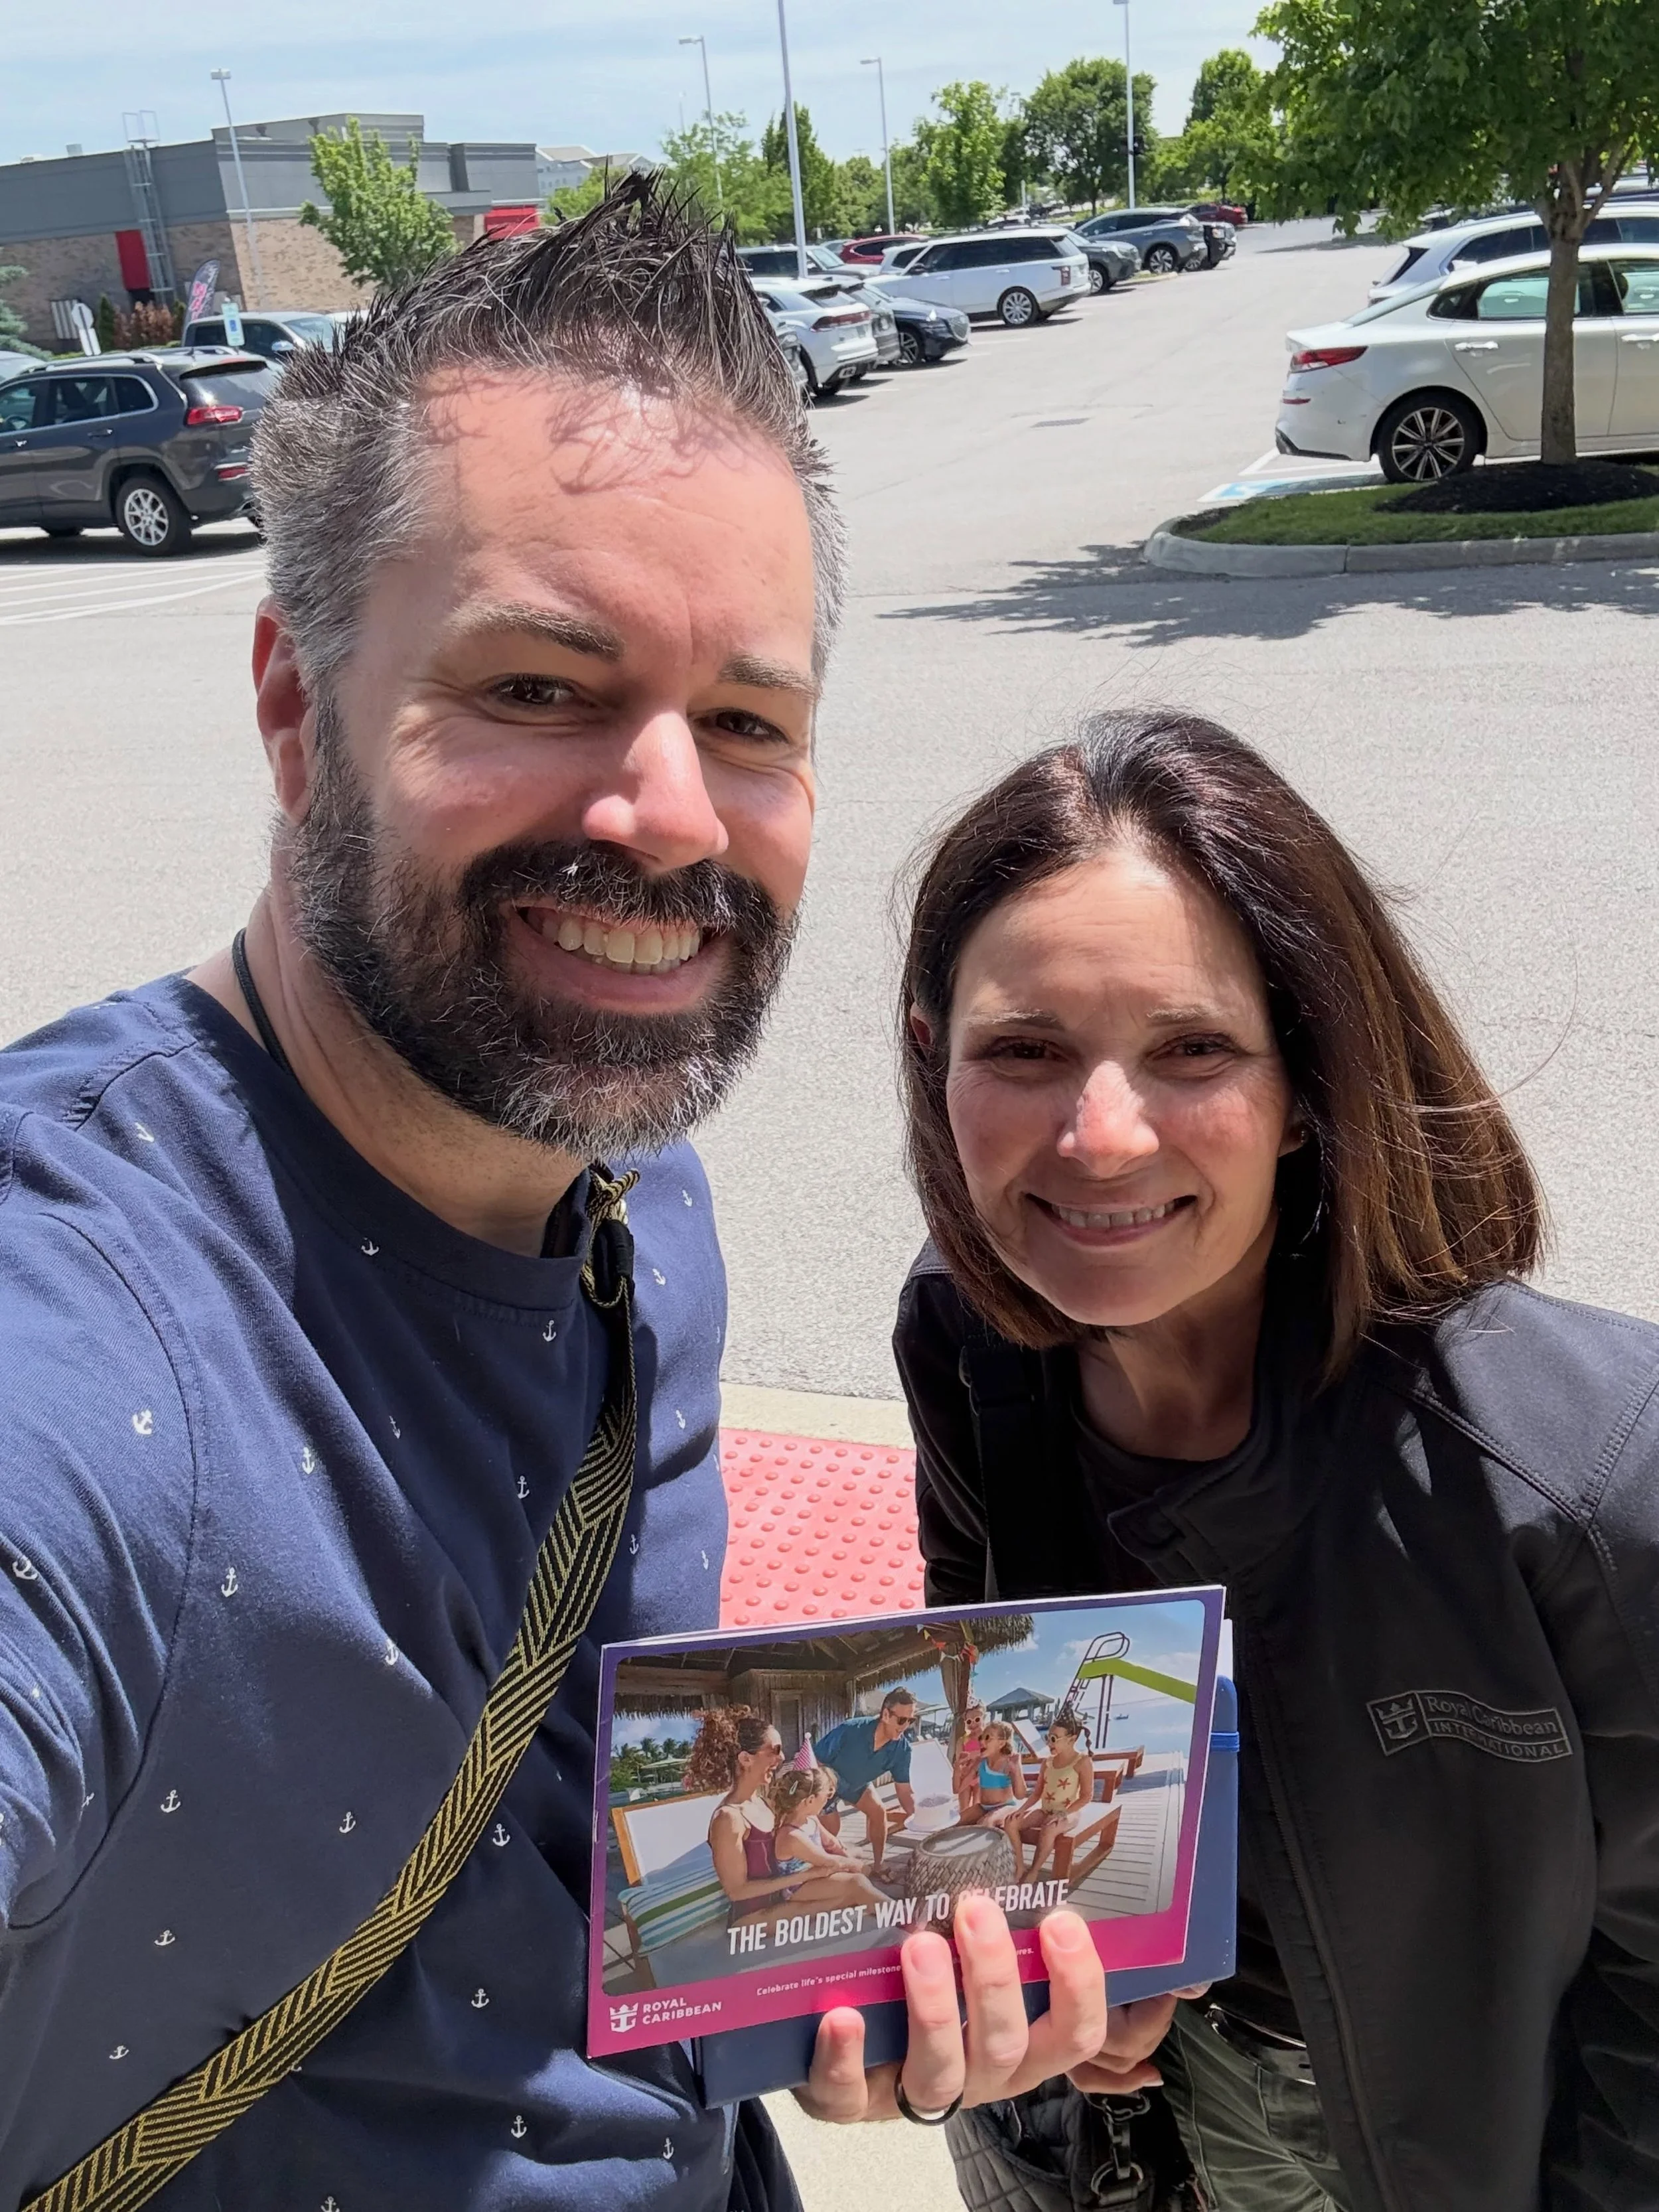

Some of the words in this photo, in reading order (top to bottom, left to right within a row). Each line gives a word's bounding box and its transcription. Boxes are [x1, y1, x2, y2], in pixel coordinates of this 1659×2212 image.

[1425, 1696, 1471, 1720] Royal
[1471, 1705, 1559, 1736] Caribbean
[727, 1923, 767, 1955] THE
[774, 1905, 867, 1947] BOLDEST
[875, 1897, 917, 1929] WAY
[925, 1893, 950, 1921] TO
[757, 1982, 799, 1996] Celebrate
[825, 1968, 857, 1984] special
[642, 1997, 687, 2014] ROYAL
[642, 2001, 722, 2025] CARIBBEAN
